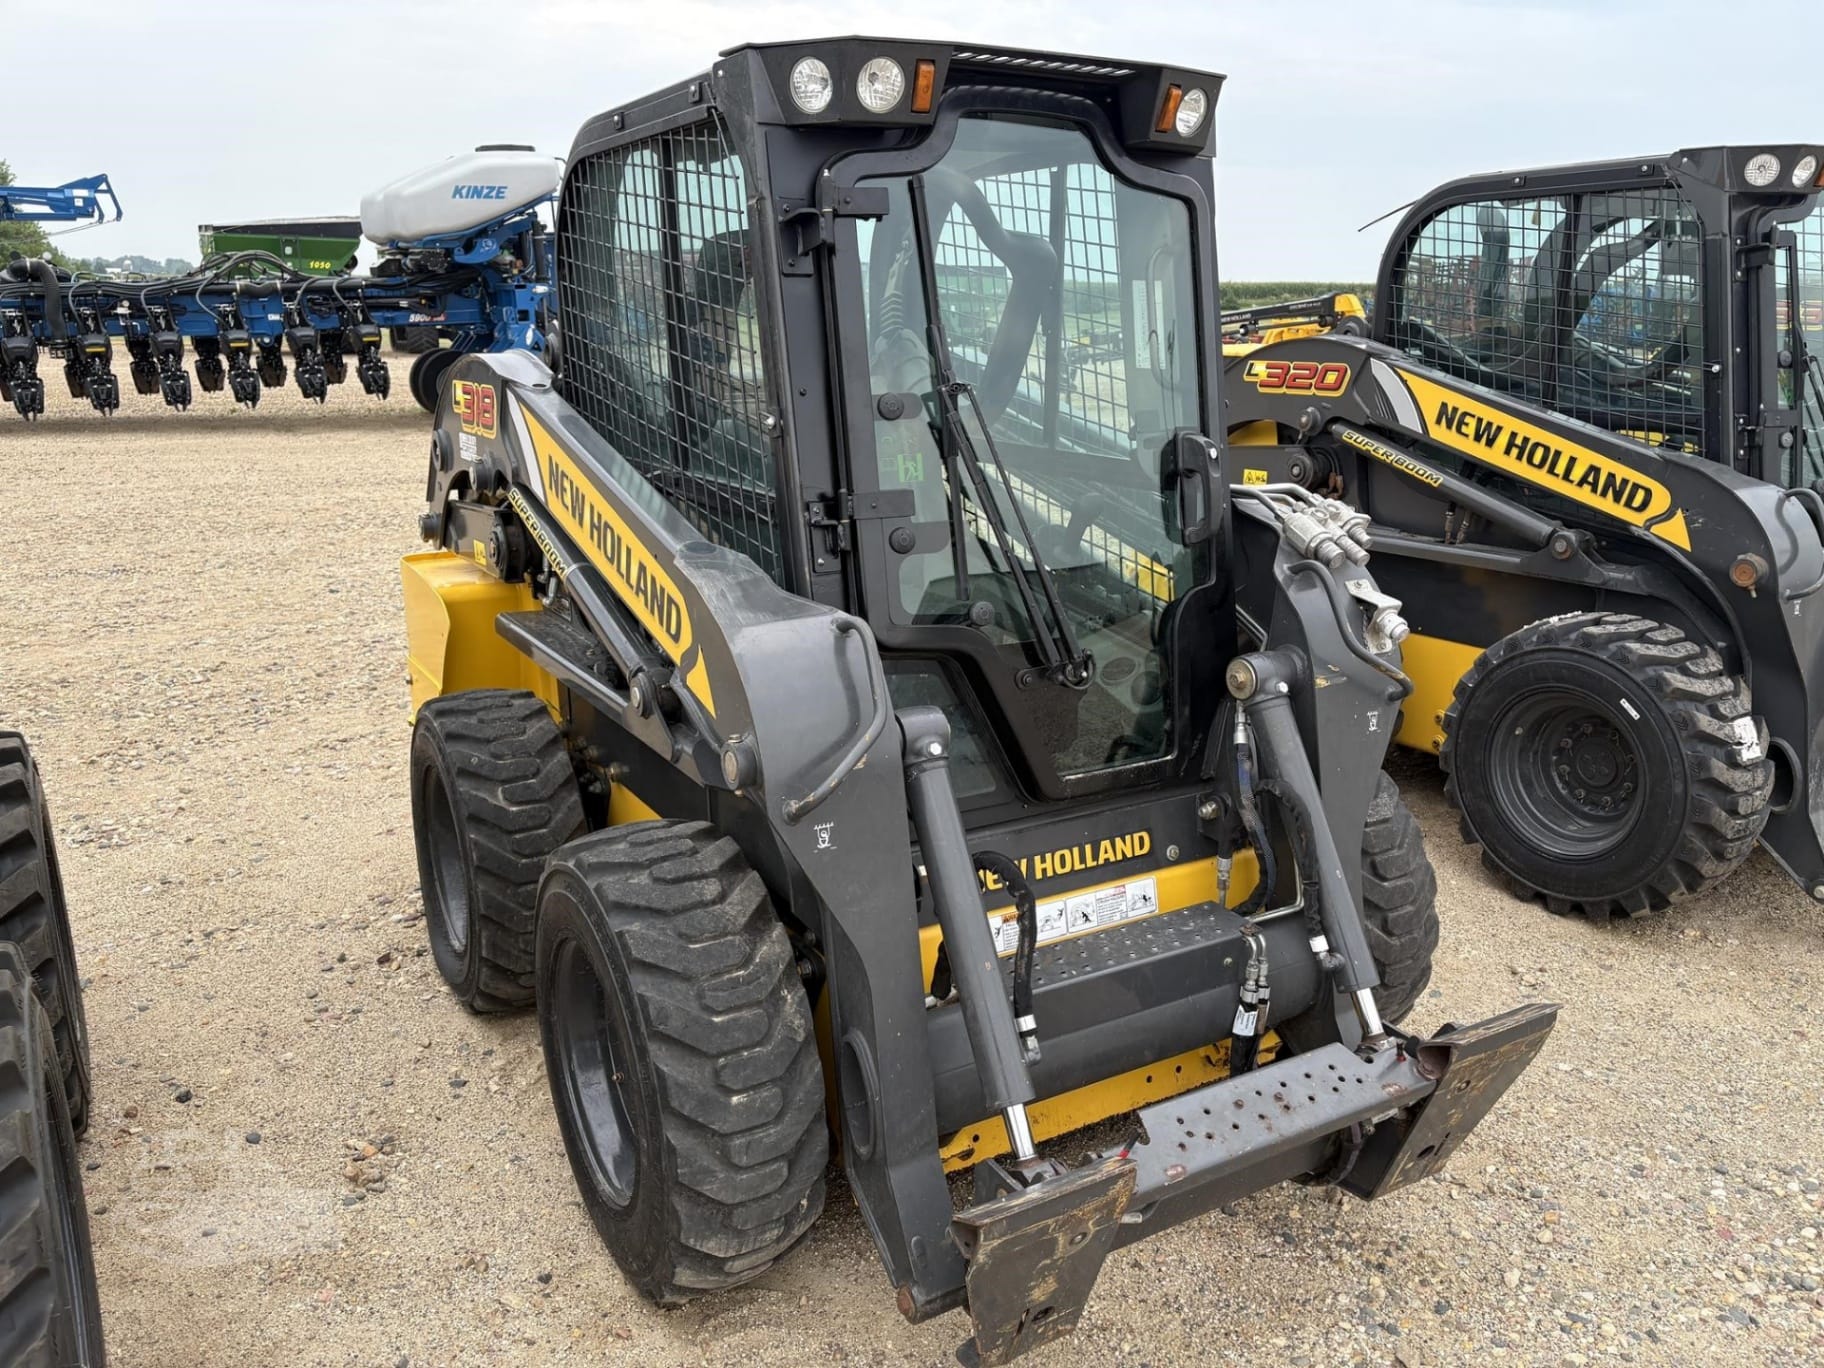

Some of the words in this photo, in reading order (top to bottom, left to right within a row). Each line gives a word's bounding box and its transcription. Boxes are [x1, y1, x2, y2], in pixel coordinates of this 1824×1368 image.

[451, 185, 508, 199] KINZE
[1244, 361, 1350, 394] L320
[452, 380, 496, 435] L318
[1435, 401, 1503, 448] NEW
[1503, 431, 1653, 512] HOLLAND
[548, 455, 585, 528] NEW
[590, 503, 682, 644] HOLLAND
[1034, 831, 1151, 879] HOLLAND
